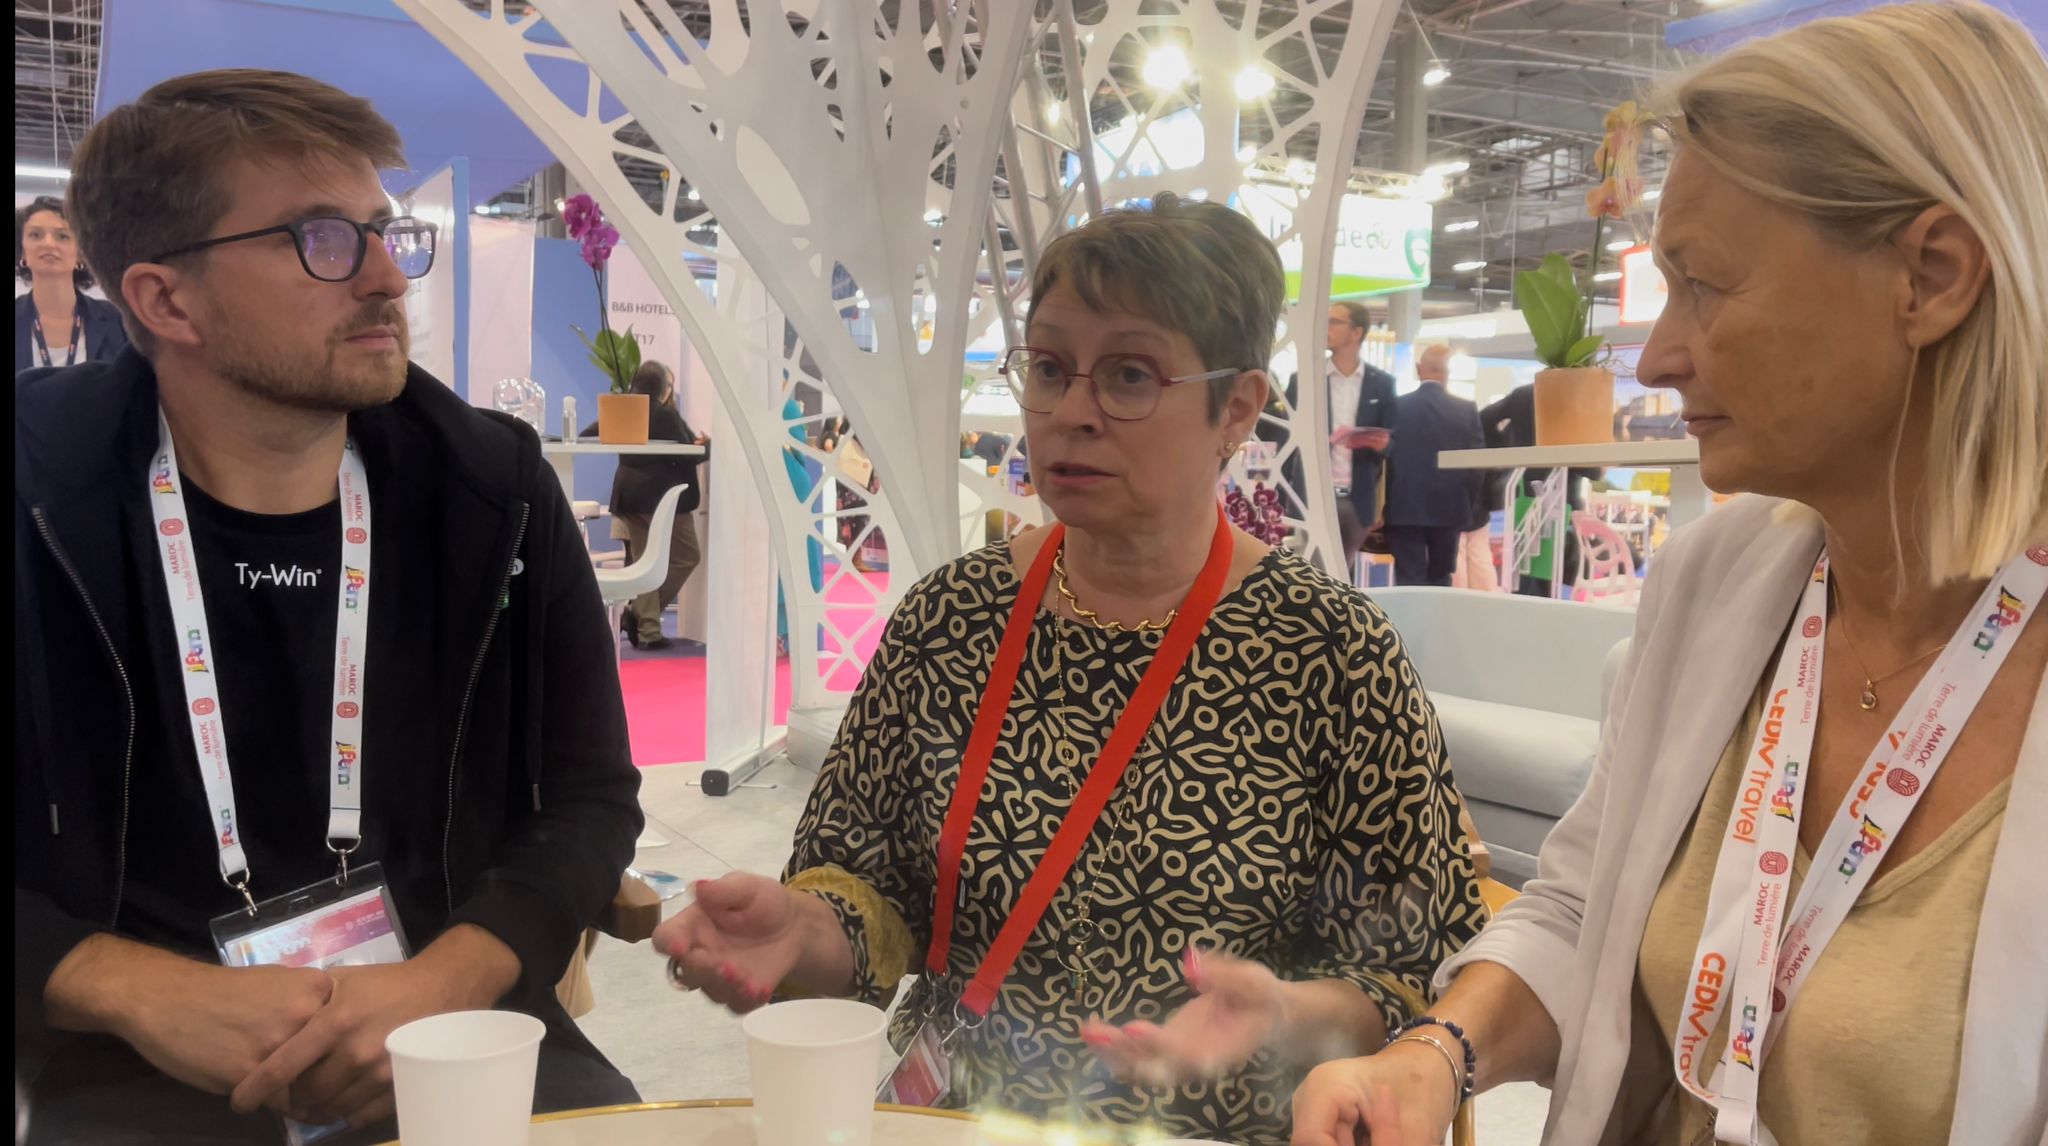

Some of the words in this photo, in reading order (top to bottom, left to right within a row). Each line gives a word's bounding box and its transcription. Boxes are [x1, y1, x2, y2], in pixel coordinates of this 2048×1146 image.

[612, 301, 634, 312] B&B
[354, 494, 364, 522] MAROC
[166, 542, 180, 574] MAROC
[234, 562, 317, 590] Ty-Win
[348, 664, 357, 696] MAROC
[1797, 646, 1810, 688] MAROC
[1806, 645, 1818, 683] lumière
[1803, 685, 1815, 697] de
[1933, 682, 1956, 708] Terre
[1800, 700, 1812, 724] Terre
[1924, 708, 1939, 723] de
[199, 722, 211, 754] MAROC
[1902, 724, 1933, 760] lumière
[1914, 724, 1946, 768] MAROC
[1753, 881, 1769, 926] MAROC
[1763, 883, 1782, 923] lumière
[1760, 925, 1772, 938] de
[1757, 940, 1770, 966] Terre
[1782, 944, 1811, 986] MAROC
